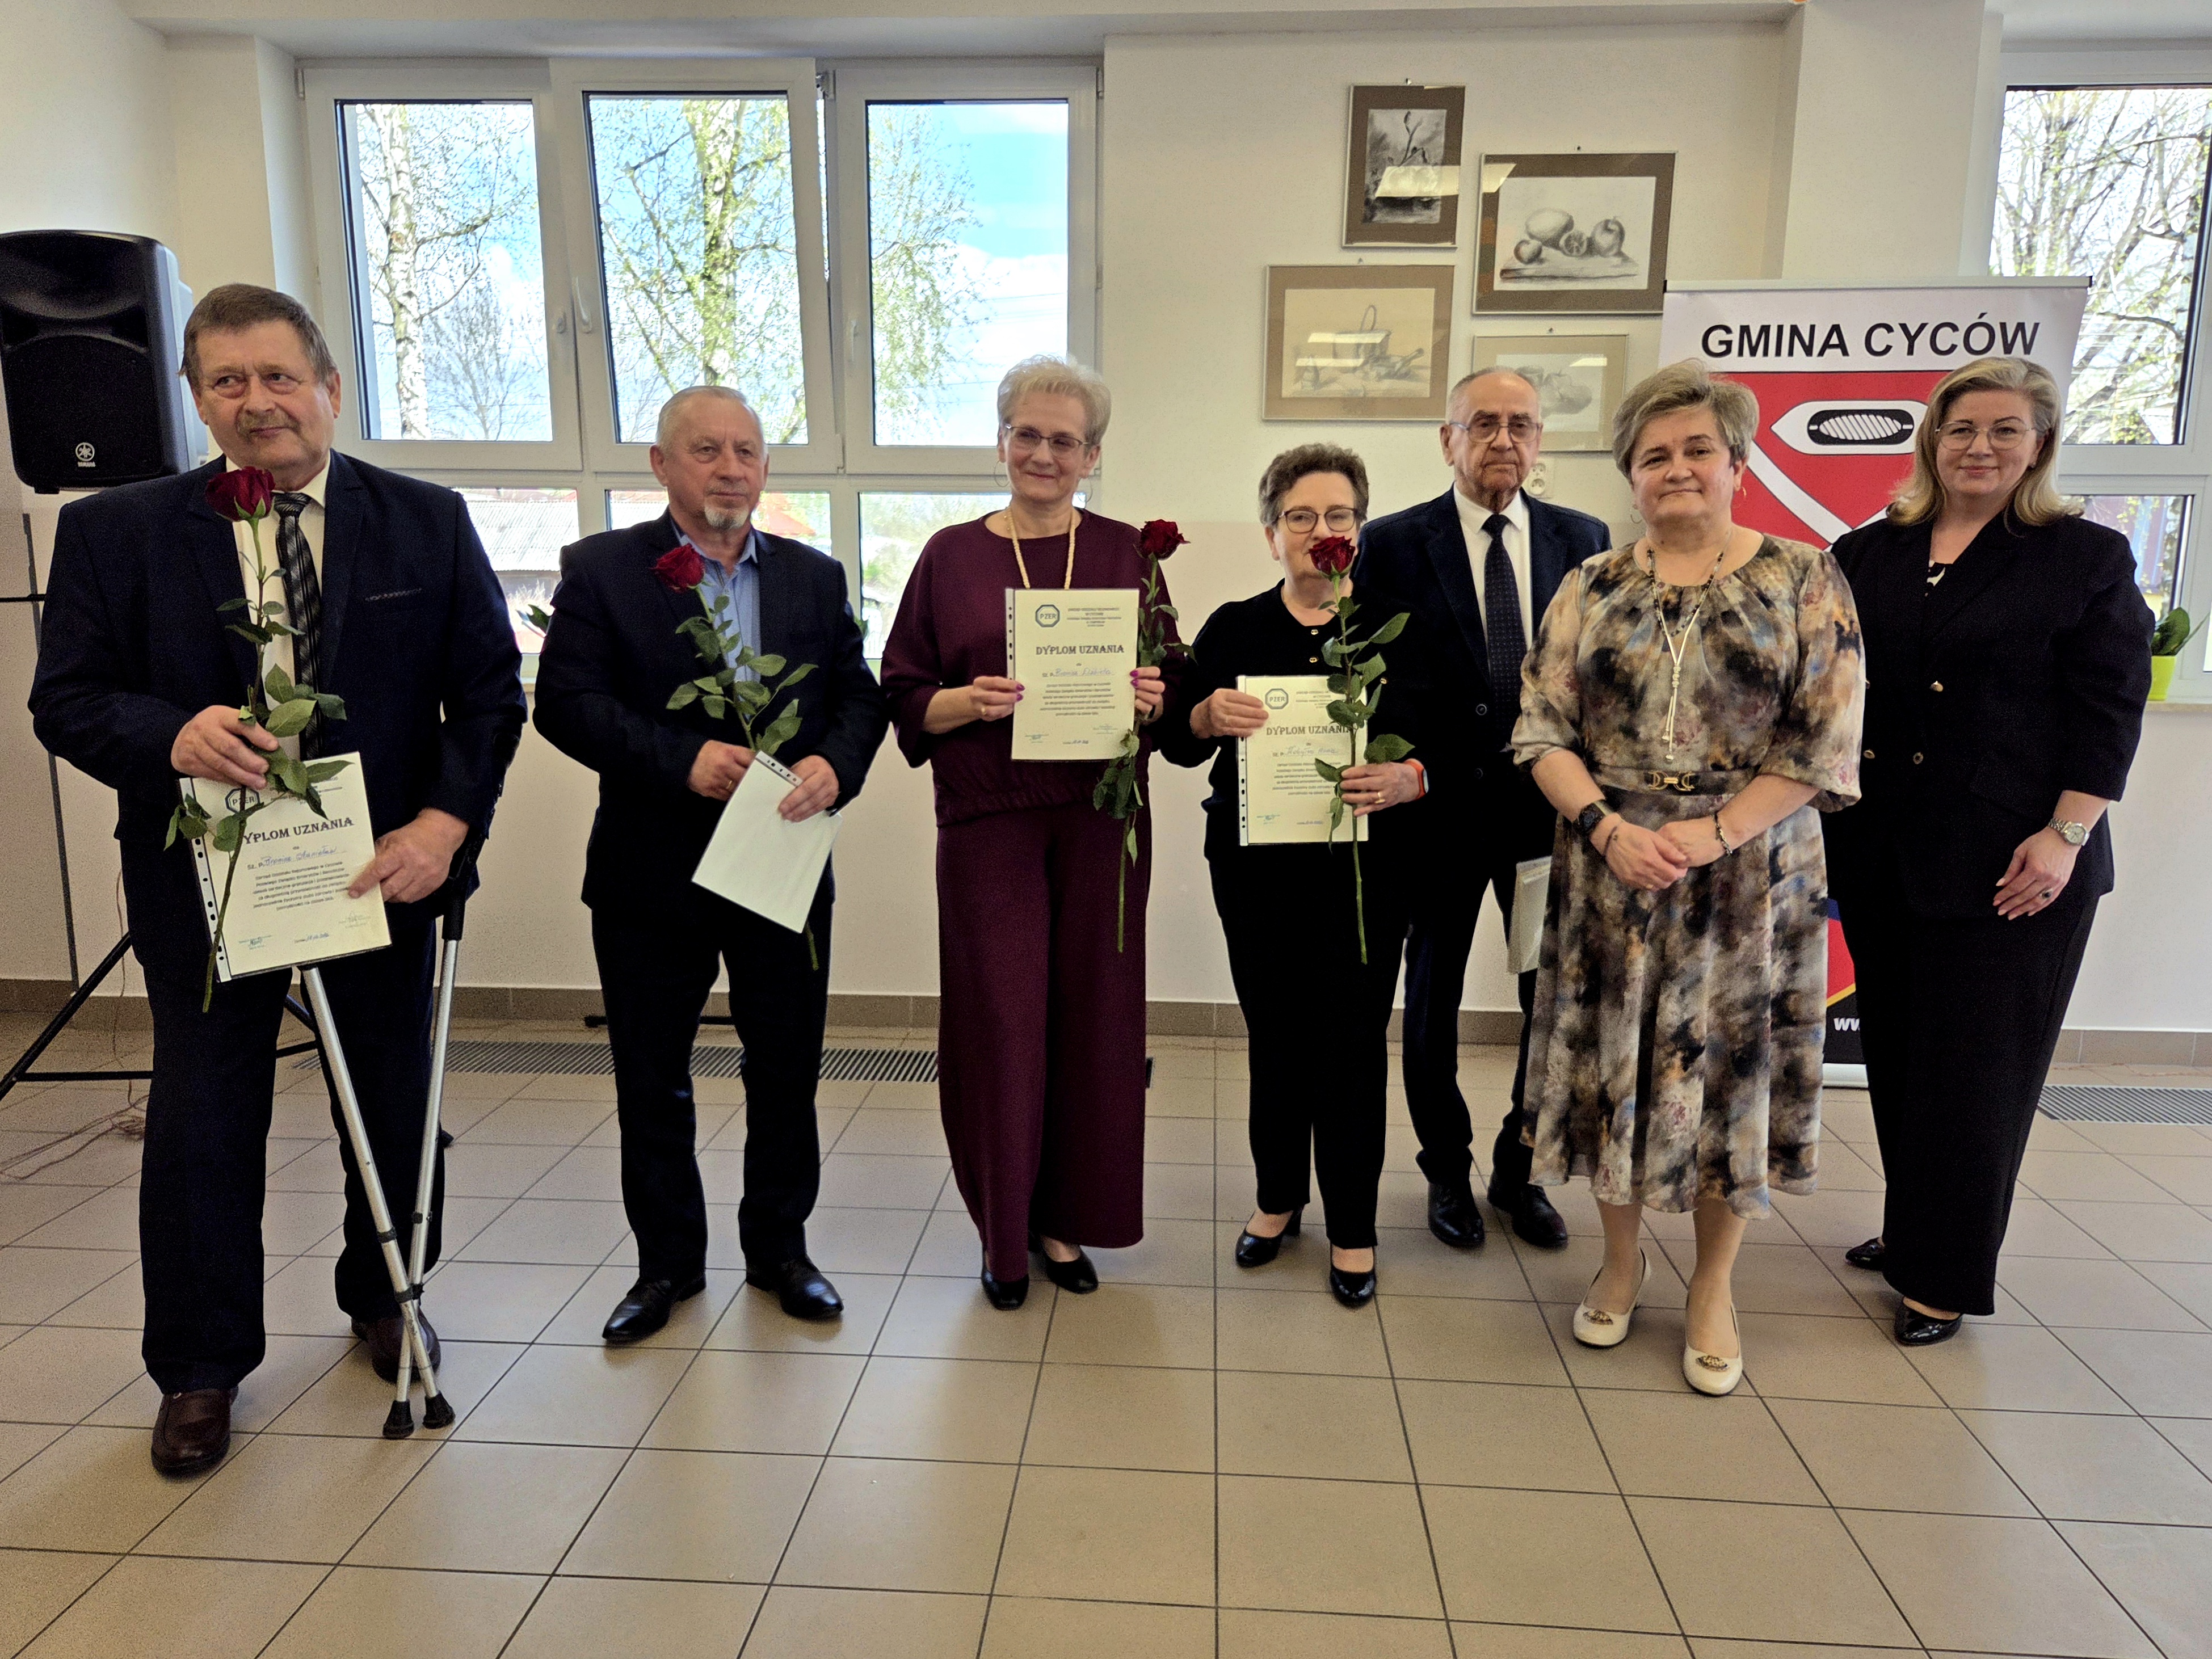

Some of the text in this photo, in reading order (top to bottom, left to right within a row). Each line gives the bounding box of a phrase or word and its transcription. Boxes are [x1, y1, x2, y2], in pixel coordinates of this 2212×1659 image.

[1702, 312, 2039, 358] GMINA CYCÓW
[1036, 645, 1124, 655] DYPLOM UZNANIA
[1266, 726, 1305, 735] DYPLOM
[232, 795, 255, 806] PER
[243, 817, 355, 844] YPLOM UZNANIA
